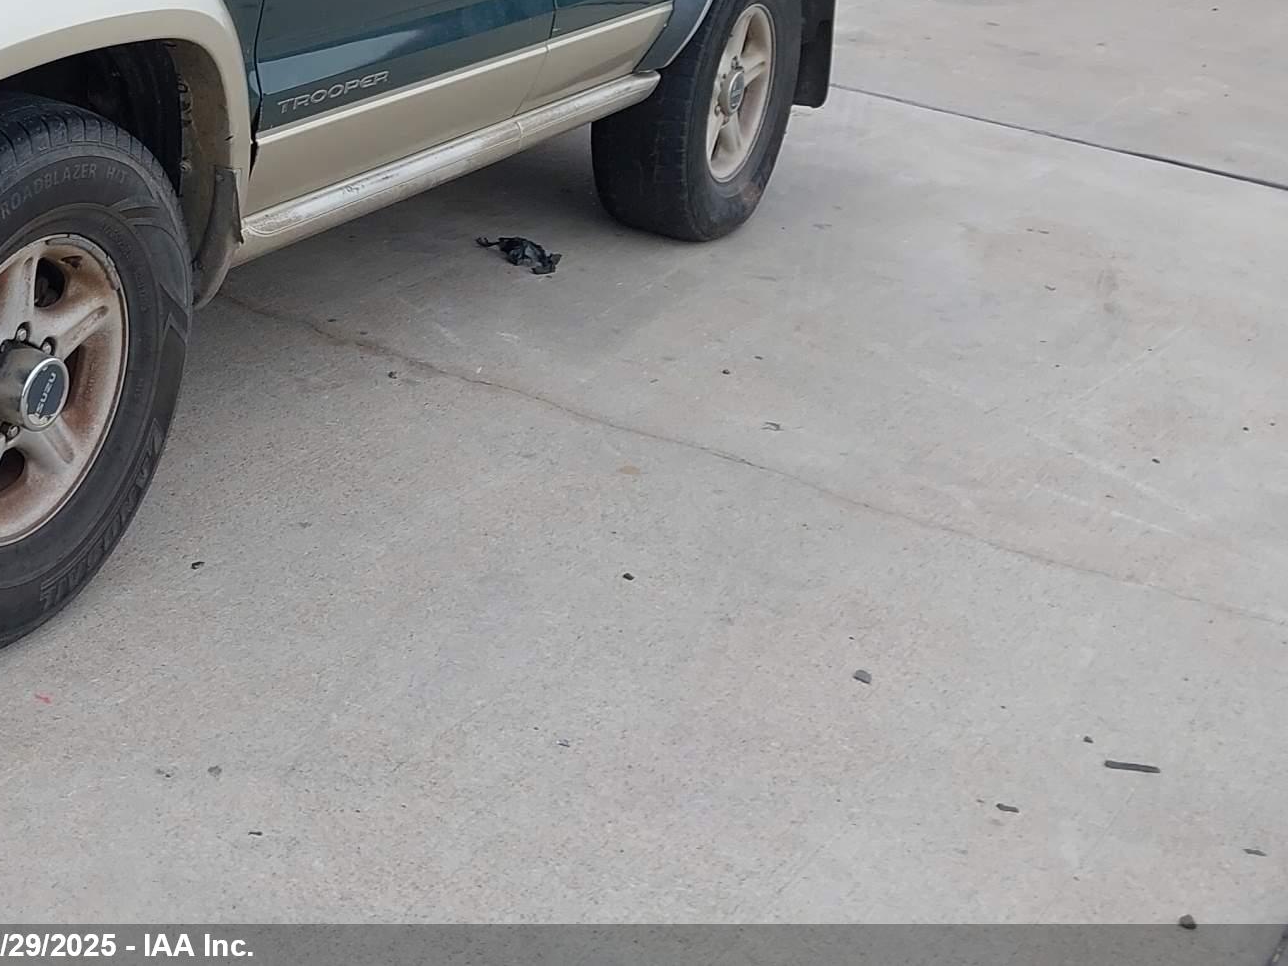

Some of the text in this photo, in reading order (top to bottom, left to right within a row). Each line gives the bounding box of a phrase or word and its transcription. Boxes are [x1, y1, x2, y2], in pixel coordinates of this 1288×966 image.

[277, 70, 389, 114] TROOPER
[0, 163, 97, 220] ROADBLAZER
[35, 372, 57, 419] ISUZU
